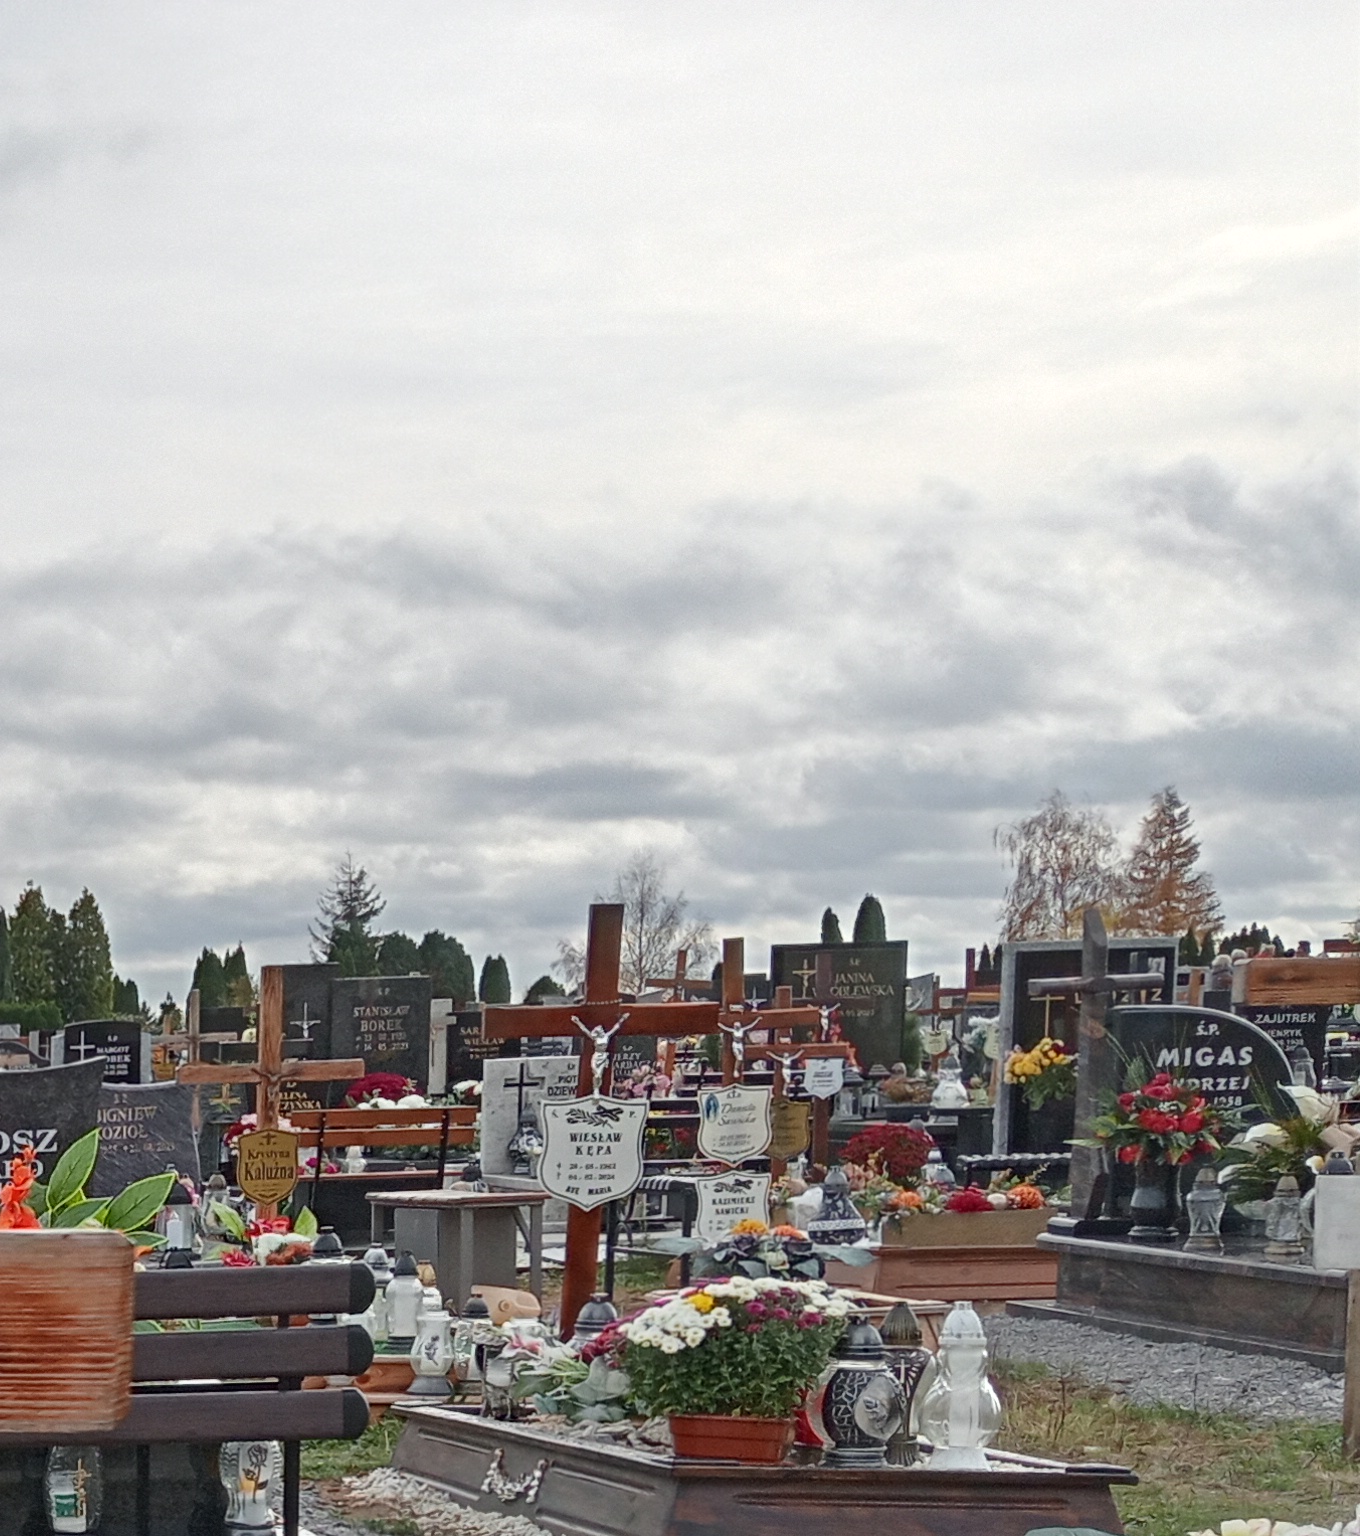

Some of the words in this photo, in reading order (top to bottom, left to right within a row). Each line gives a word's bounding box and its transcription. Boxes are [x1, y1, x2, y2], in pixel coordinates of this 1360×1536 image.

[834, 972, 875, 984] JANINA
[1254, 1012, 1317, 1024] ZAJUTREK
[360, 1019, 404, 1032] BOREK
[1156, 1046, 1254, 1068] MIGAS
[558, 1074, 578, 1084] PIOT
[1171, 1076, 1250, 1092] NDRZEJ
[569, 1132, 623, 1143] WIESŁAW
[247, 1148, 291, 1161] Krystyna
[575, 1145, 612, 1157] KĘPA
[587, 1185, 613, 1196] MARIA
